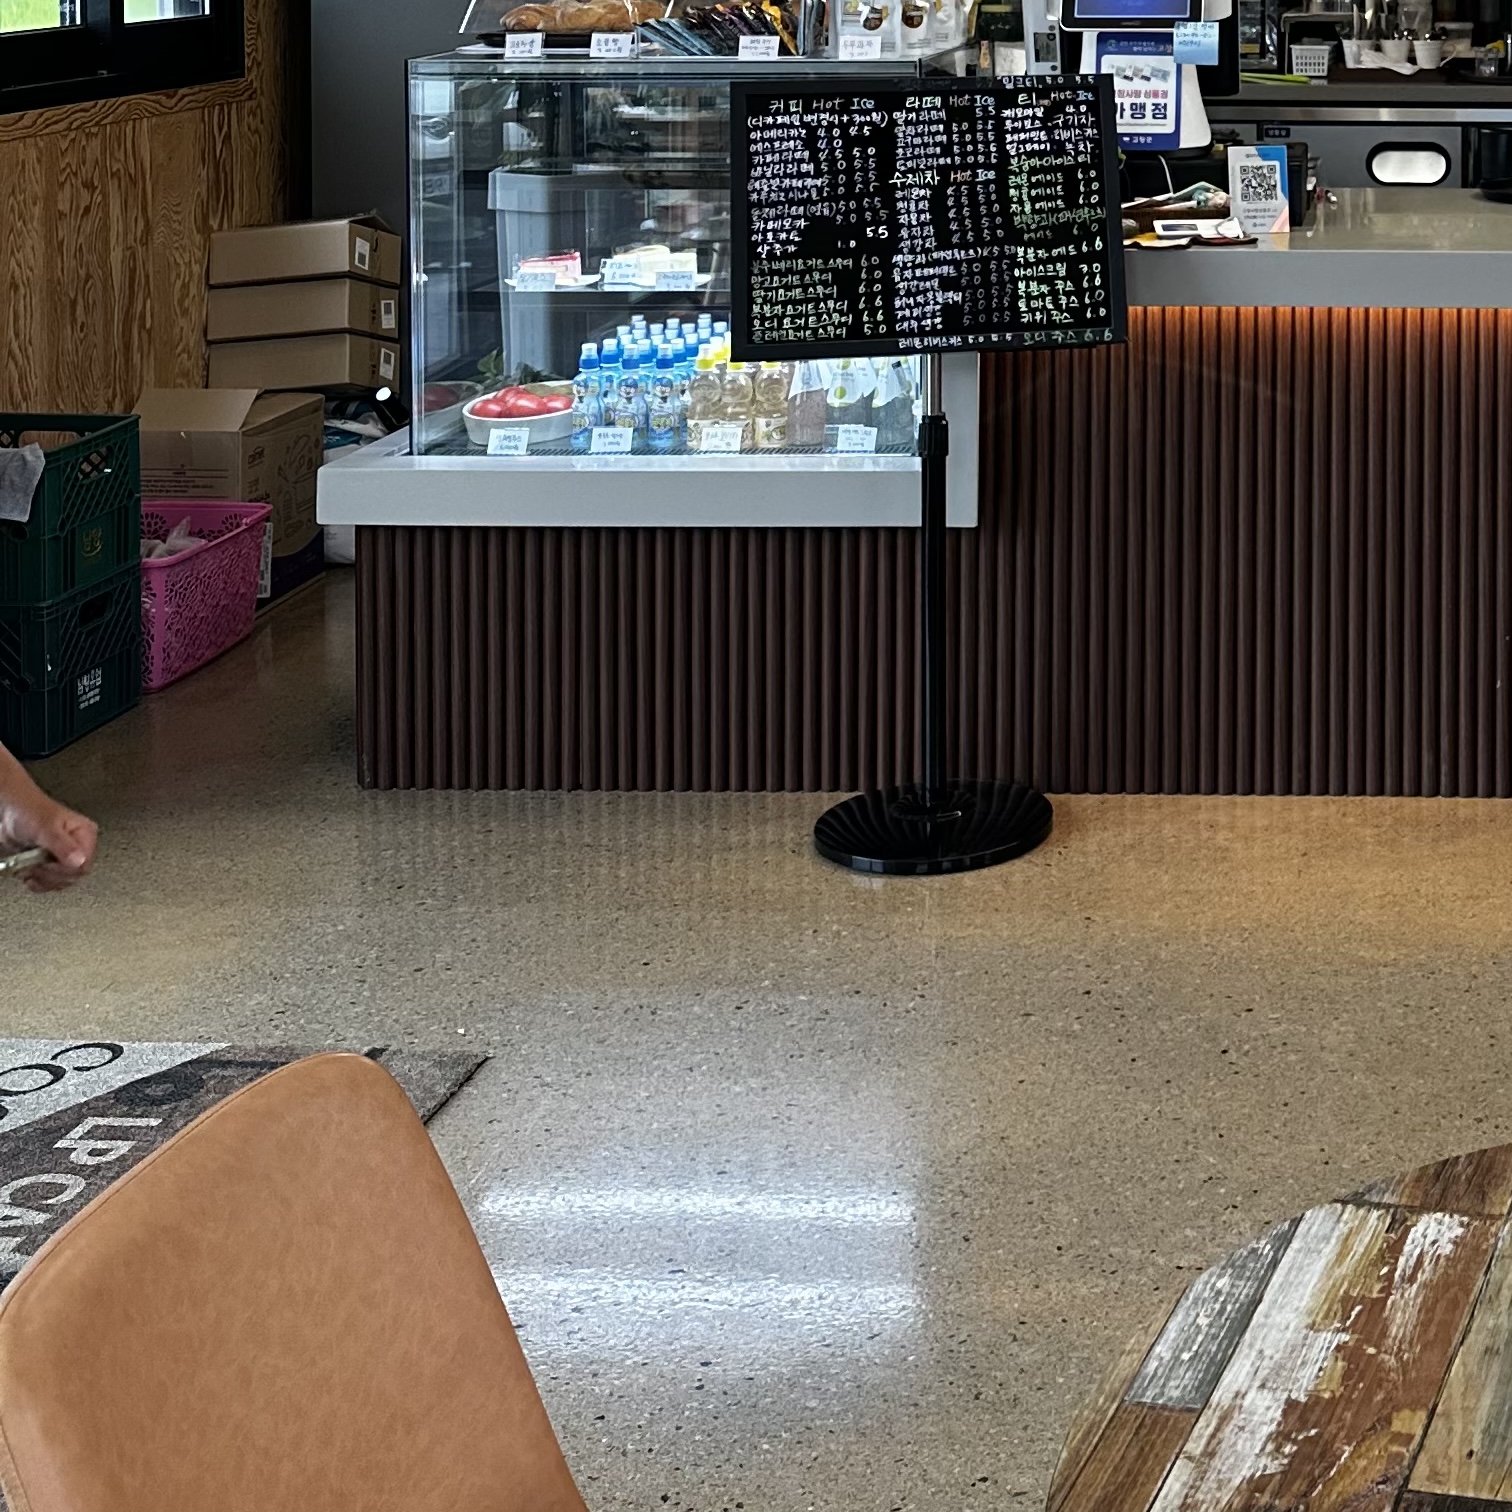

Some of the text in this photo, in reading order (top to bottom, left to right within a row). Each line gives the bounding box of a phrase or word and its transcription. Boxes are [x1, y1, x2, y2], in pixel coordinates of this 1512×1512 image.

[1017, 90, 1096, 106] 티 Hot Ice
[1114, 89, 1141, 99] 창사랑
[768, 97, 876, 113] 커피 Hot Ice
[905, 94, 996, 109] 라떼 Hot Ice
[750, 128, 807, 140] 아메리카노
[750, 139, 806, 153] 에스프레소
[751, 150, 810, 165] 카페라떼
[888, 169, 997, 188] 수제차 Hot Ice
[866, 225, 889, 239] 5.5
[1016, 245, 1050, 264] 복분자
[826, 257, 853, 271] 스무디
[1013, 261, 1067, 278] 아이스크림
[803, 271, 832, 285] 스무디
[806, 284, 837, 299] 스무디
[1017, 279, 1051, 297] 복분자
[817, 299, 848, 313] 스무디
[1017, 296, 1055, 312] 토마토
[751, 318, 778, 331] 오디
[1020, 311, 1048, 325] 키위
[817, 325, 847, 339] 스무디
[1022, 332, 1047, 346] 오디
[53, 1116, 163, 1166] LP
